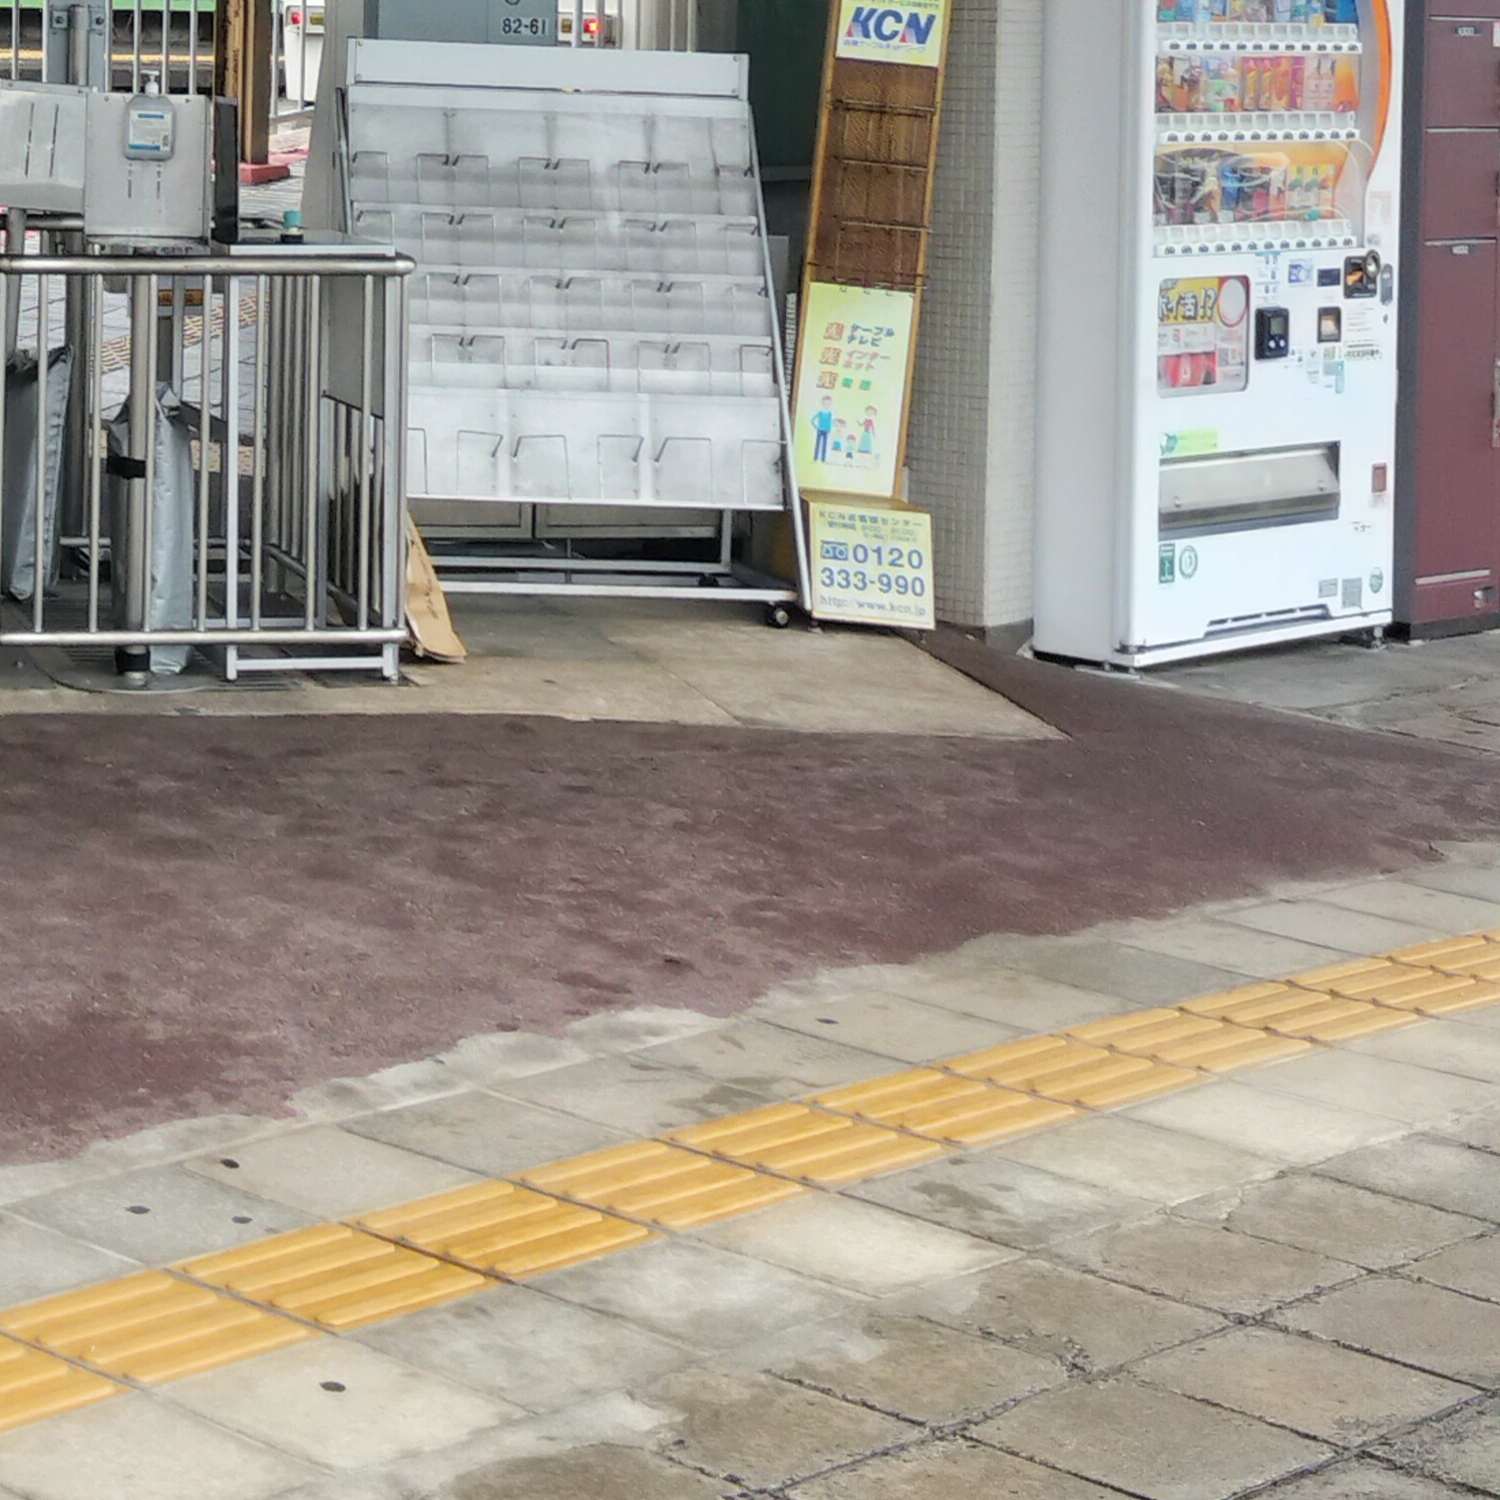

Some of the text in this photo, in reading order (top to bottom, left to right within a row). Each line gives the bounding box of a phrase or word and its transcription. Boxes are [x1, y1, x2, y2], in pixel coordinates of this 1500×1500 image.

[501, 17, 547, 36] 82-61
[845, 6, 937, 46] KCN
[852, 542, 924, 570] 0120
[820, 566, 926, 597] 333-990
